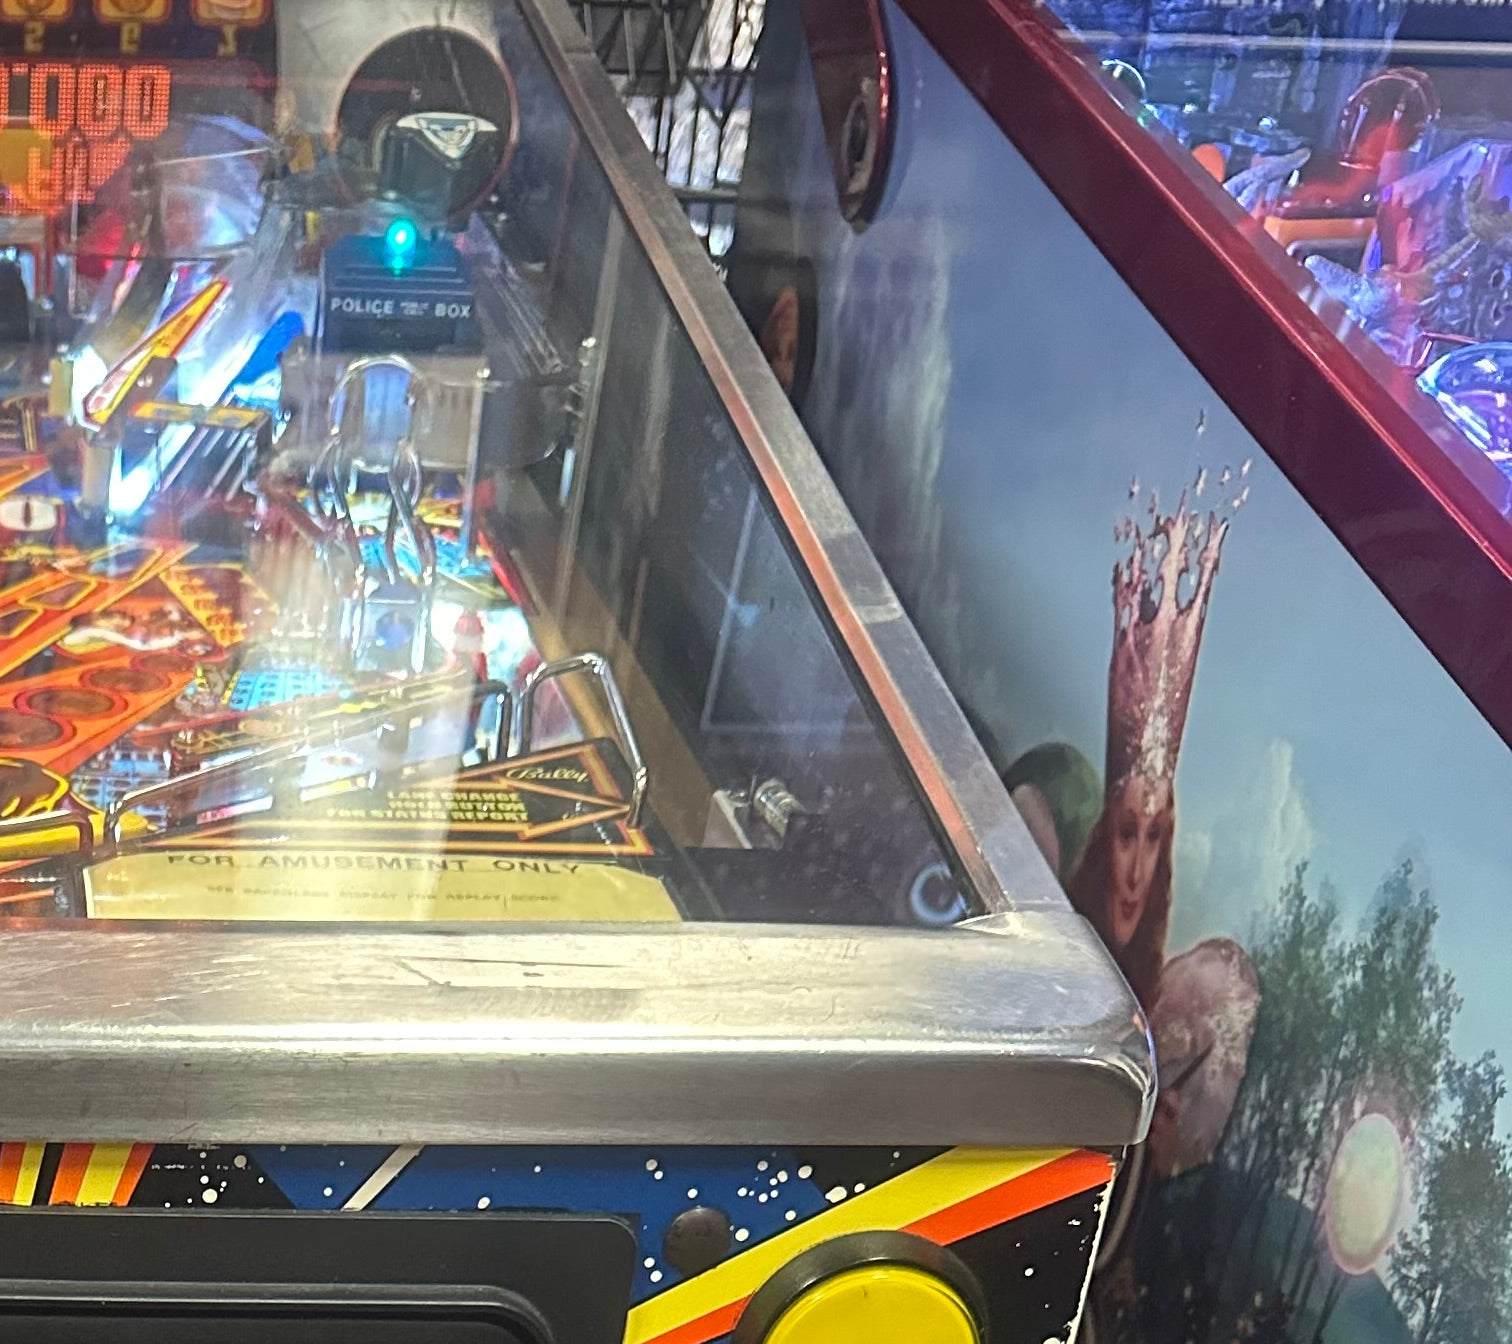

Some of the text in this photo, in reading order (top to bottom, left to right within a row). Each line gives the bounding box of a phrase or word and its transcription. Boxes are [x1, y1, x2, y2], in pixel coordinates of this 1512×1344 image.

[330, 298, 395, 315] POLICE
[434, 303, 472, 319] BOX
[506, 767, 589, 783] Bally
[167, 855, 579, 875] FOR AMUSEMENT ONLY
